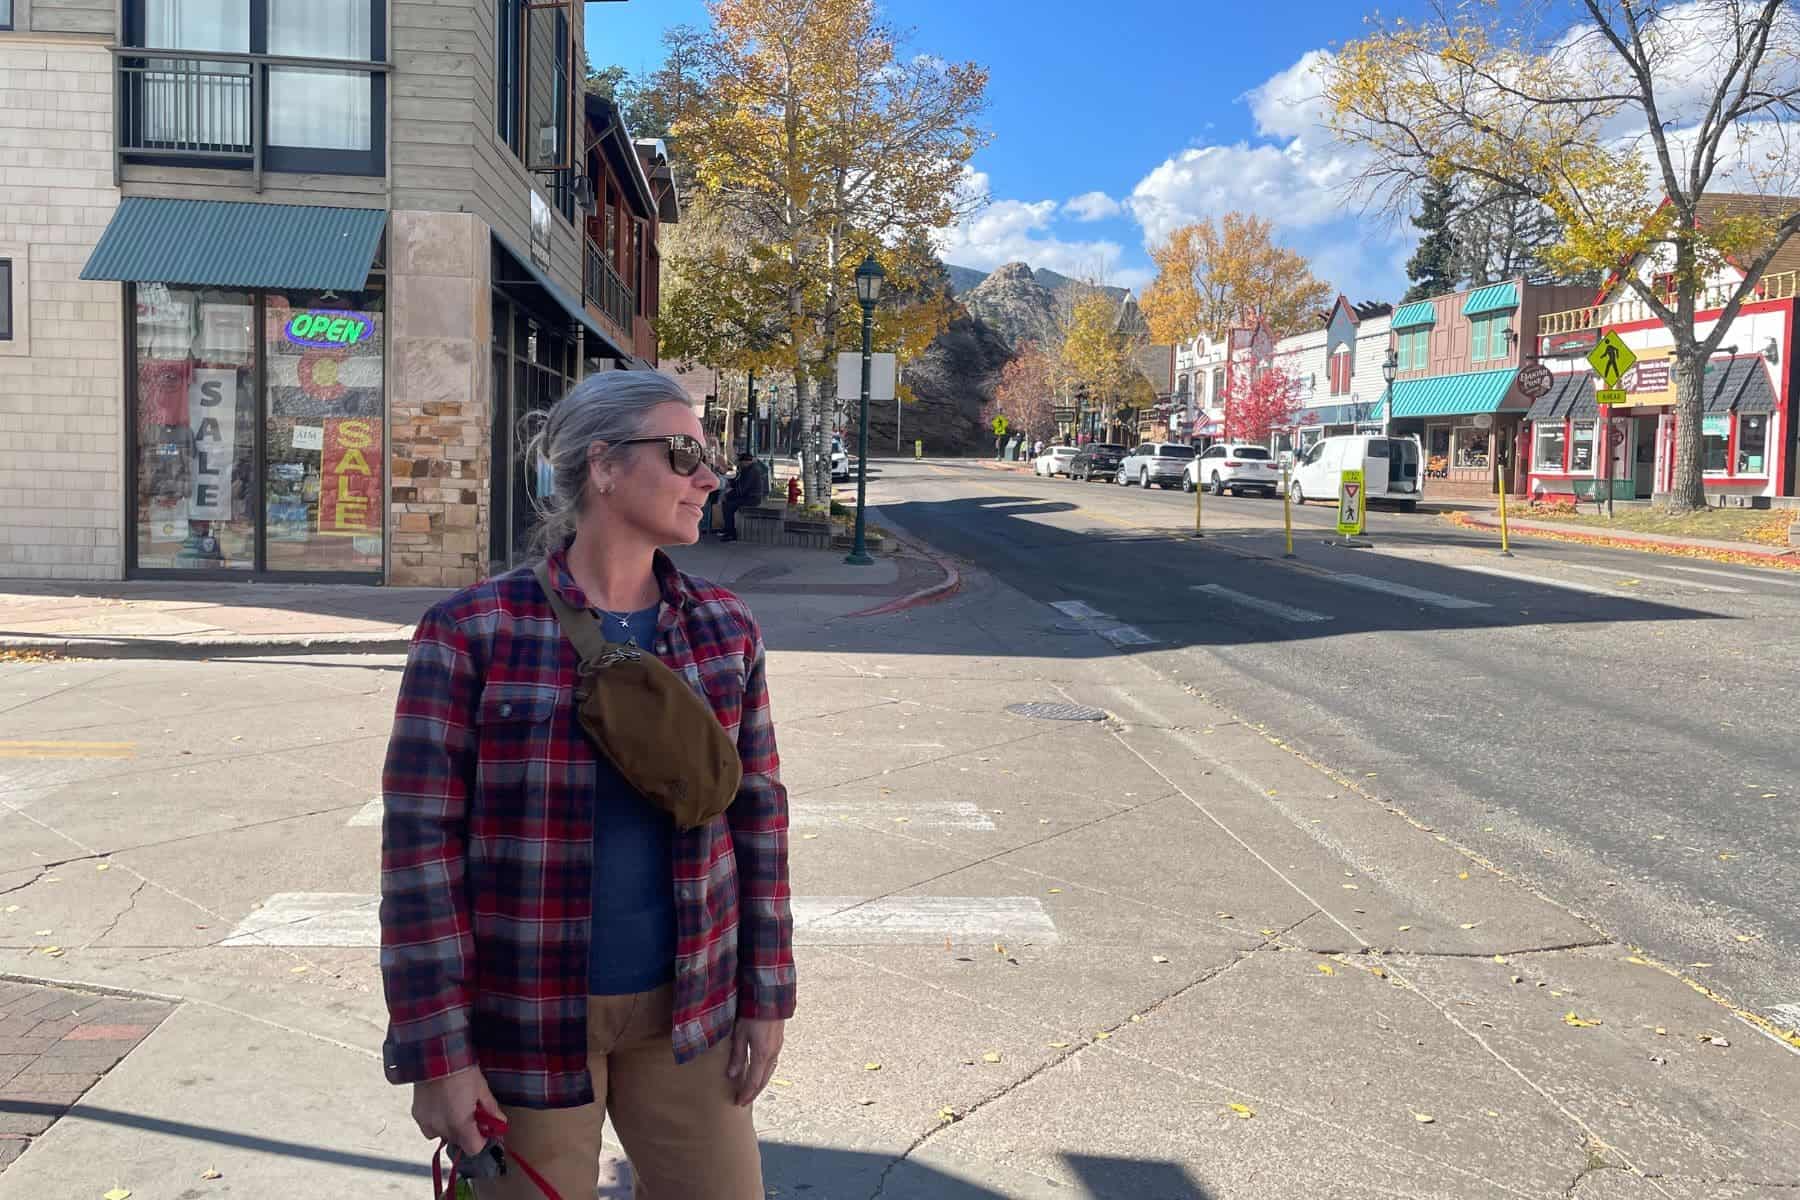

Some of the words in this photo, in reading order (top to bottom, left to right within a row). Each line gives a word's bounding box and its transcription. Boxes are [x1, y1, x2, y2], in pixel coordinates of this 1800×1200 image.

[290, 313, 365, 344] OPEN
[196, 381, 222, 507] SALE
[335, 420, 371, 529] SALE
